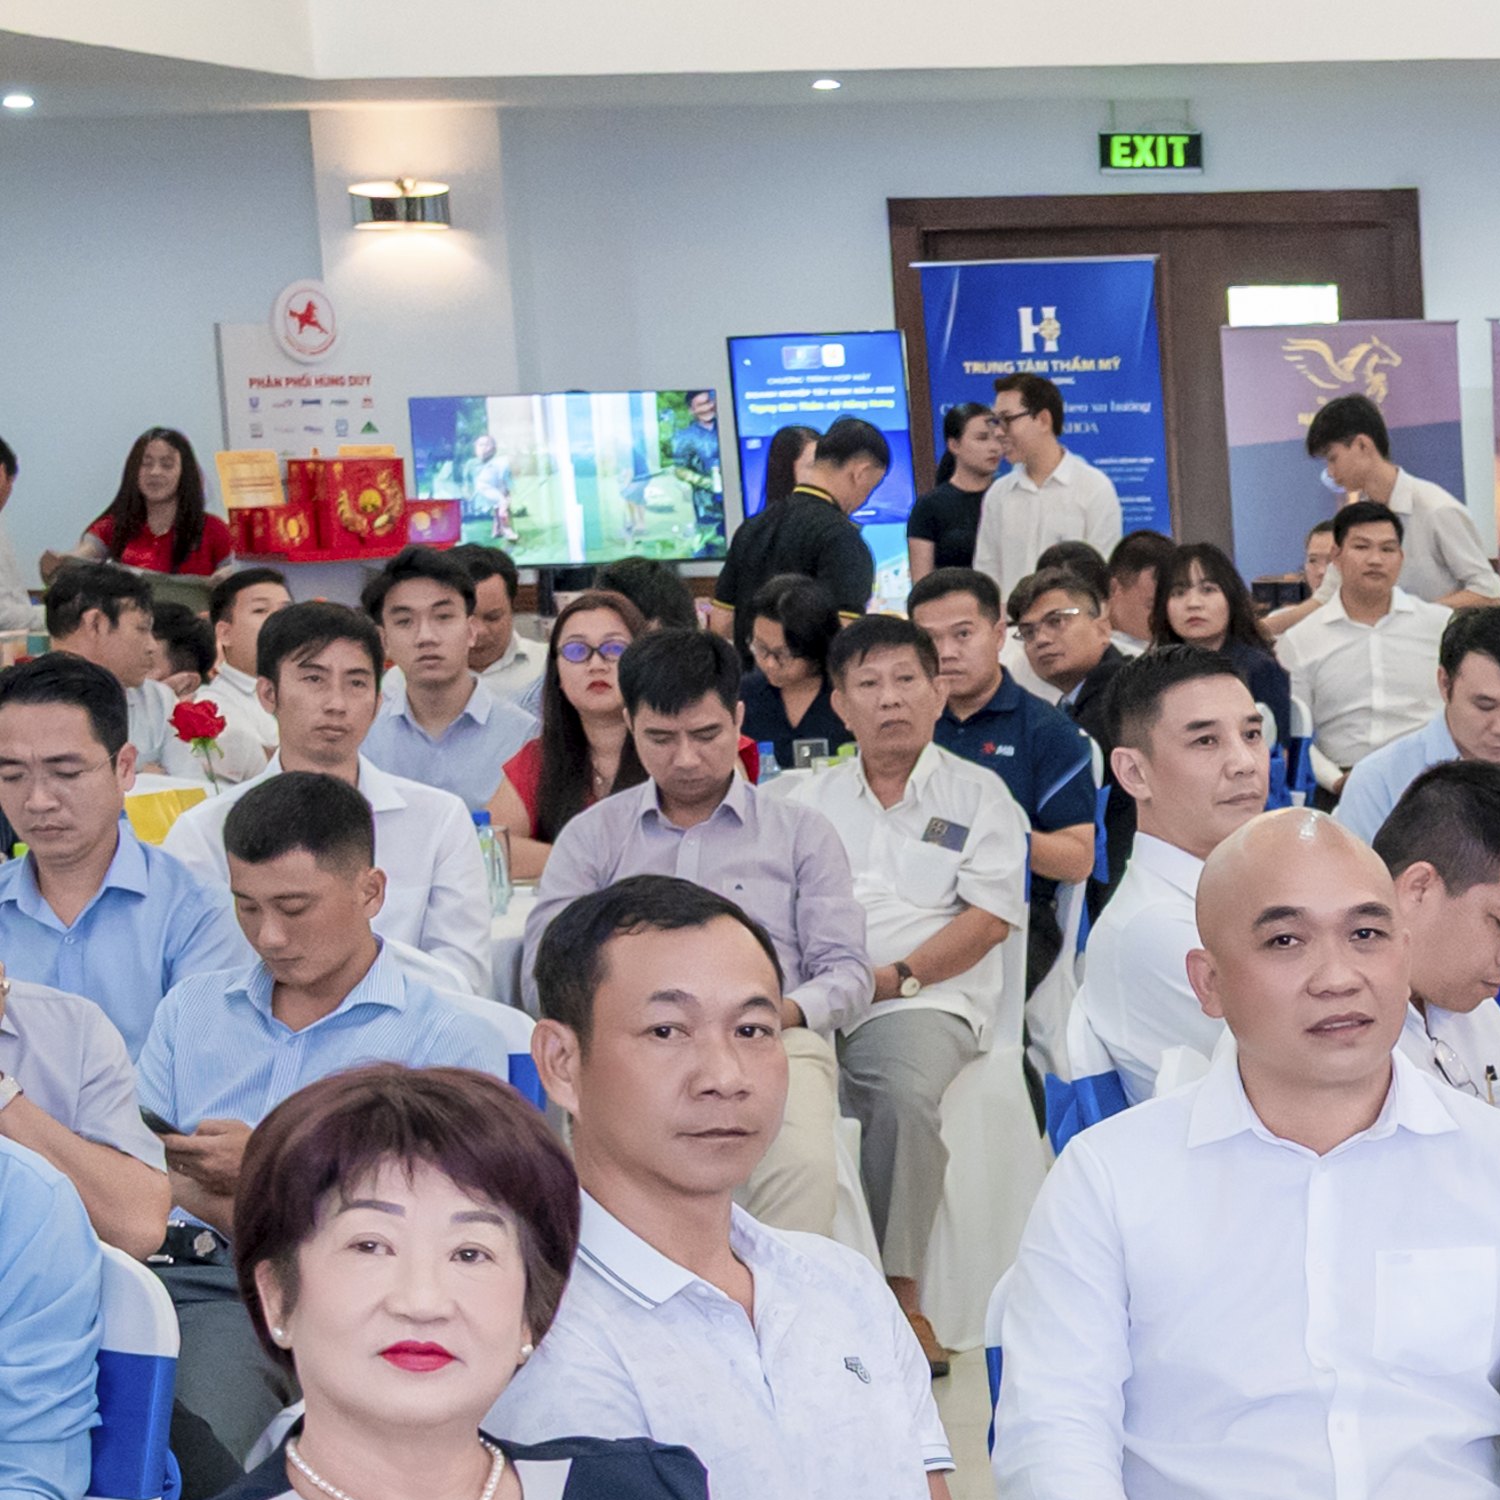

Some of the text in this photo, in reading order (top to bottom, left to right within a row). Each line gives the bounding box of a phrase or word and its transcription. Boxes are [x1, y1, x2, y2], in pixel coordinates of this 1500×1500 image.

[1110, 134, 1189, 168] EXIT
[962, 360, 1015, 375] TRUNG
[1017, 358, 1049, 373] TÂM
